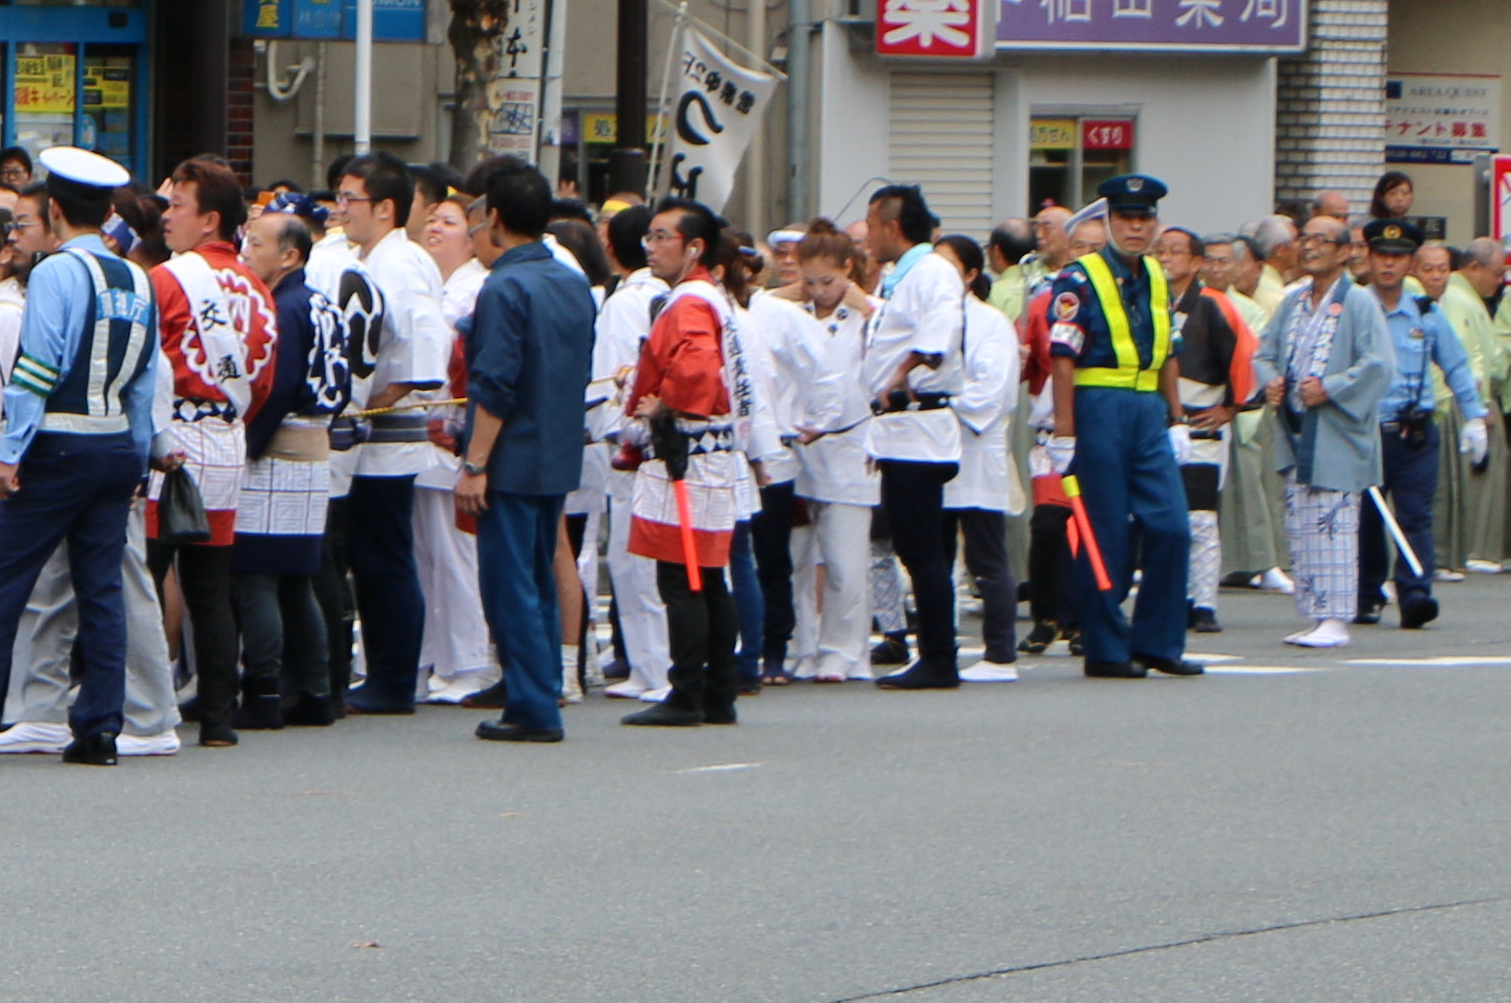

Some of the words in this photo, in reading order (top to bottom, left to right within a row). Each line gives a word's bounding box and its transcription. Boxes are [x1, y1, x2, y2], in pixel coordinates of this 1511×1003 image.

[1088, 126, 1123, 145] くすり
[101, 290, 147, 320] 警視庁
[200, 299, 243, 383] 交通
